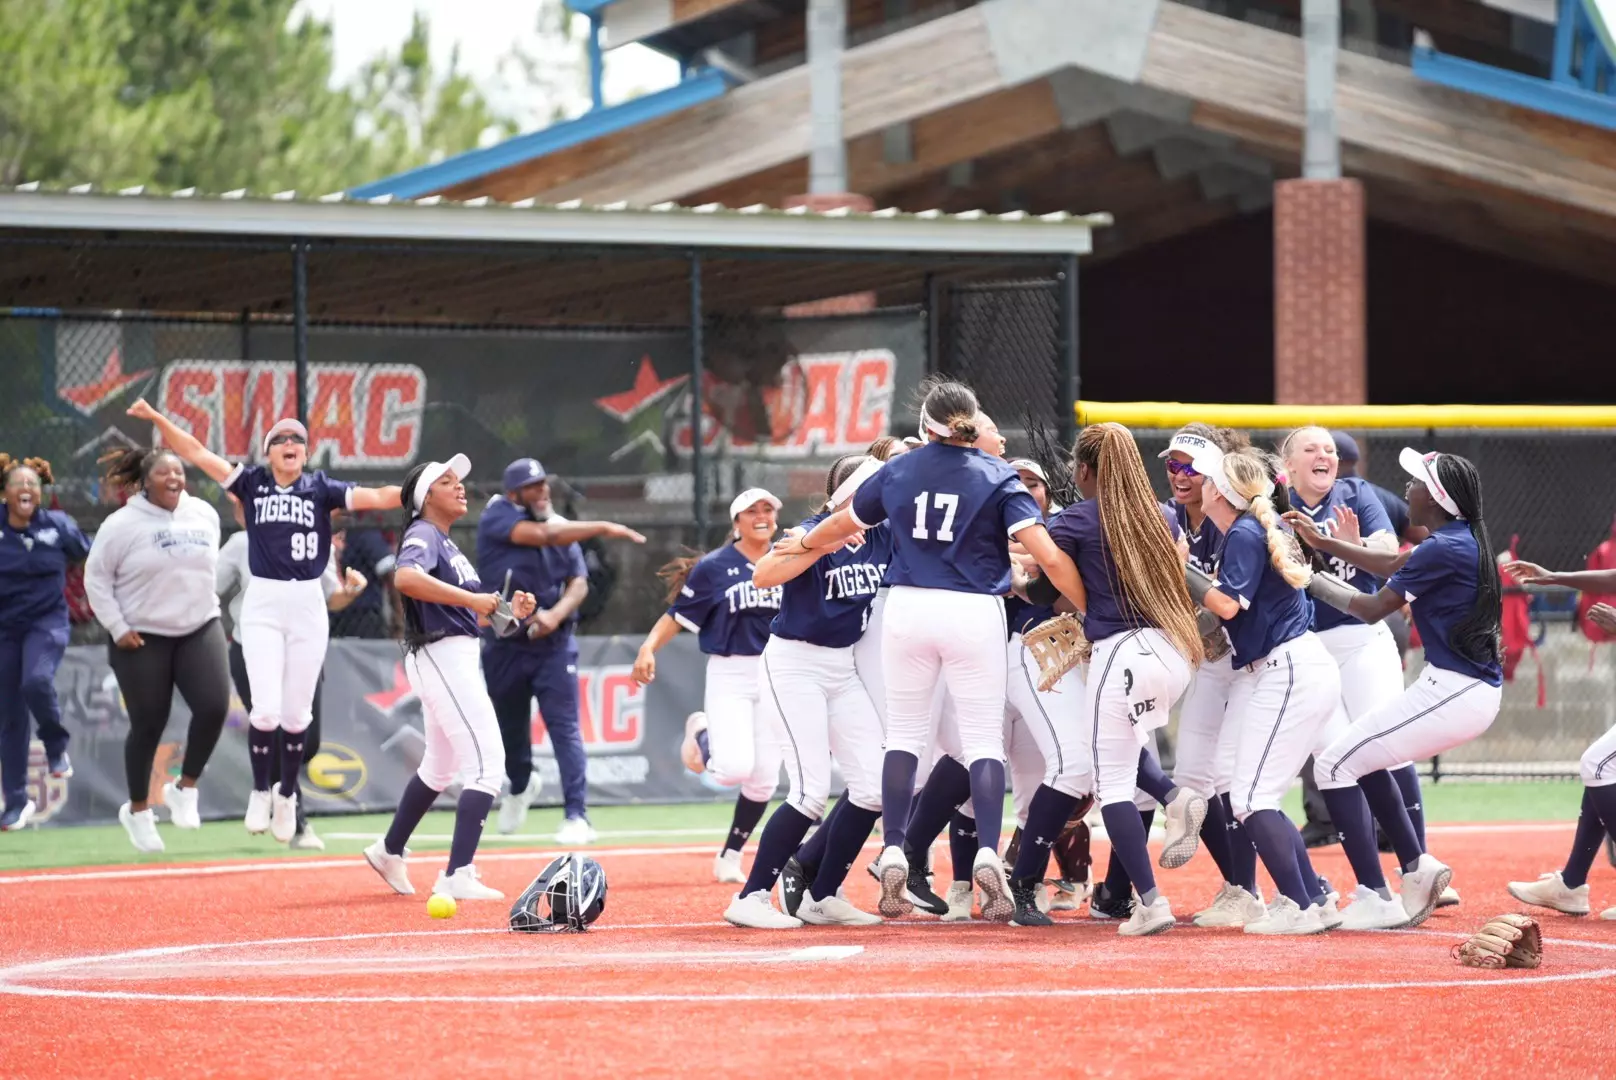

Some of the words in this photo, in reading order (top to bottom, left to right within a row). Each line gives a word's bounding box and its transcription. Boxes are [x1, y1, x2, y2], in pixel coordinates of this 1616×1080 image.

[157, 361, 425, 467] SWAC
[1174, 435, 1207, 449] TIGERS
[253, 494, 315, 529] TIGERS
[912, 491, 959, 542] 17
[291, 531, 319, 561] 99
